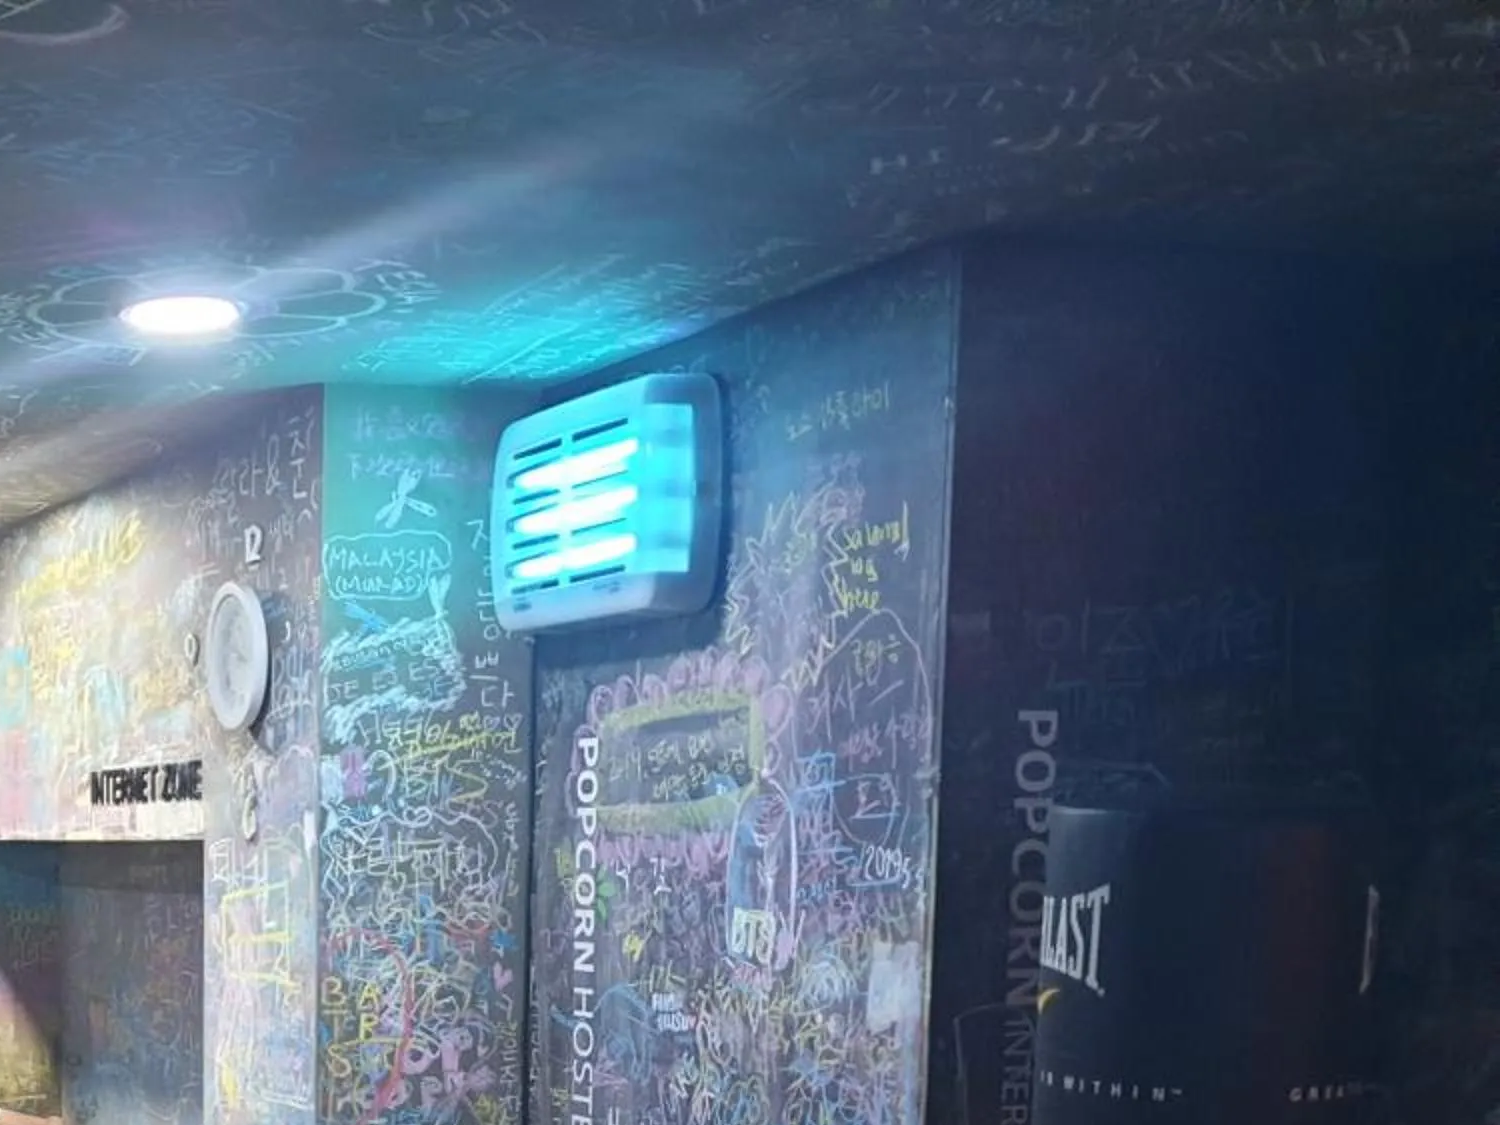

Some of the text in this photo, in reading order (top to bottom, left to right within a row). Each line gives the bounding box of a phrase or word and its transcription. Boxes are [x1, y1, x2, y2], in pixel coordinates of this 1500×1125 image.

[329, 546, 446, 575] MALAYSIA
[91, 759, 203, 806] INTERNET ZONE
[572, 736, 599, 973] POPCORN
[1005, 710, 1059, 1008] POPCORN
